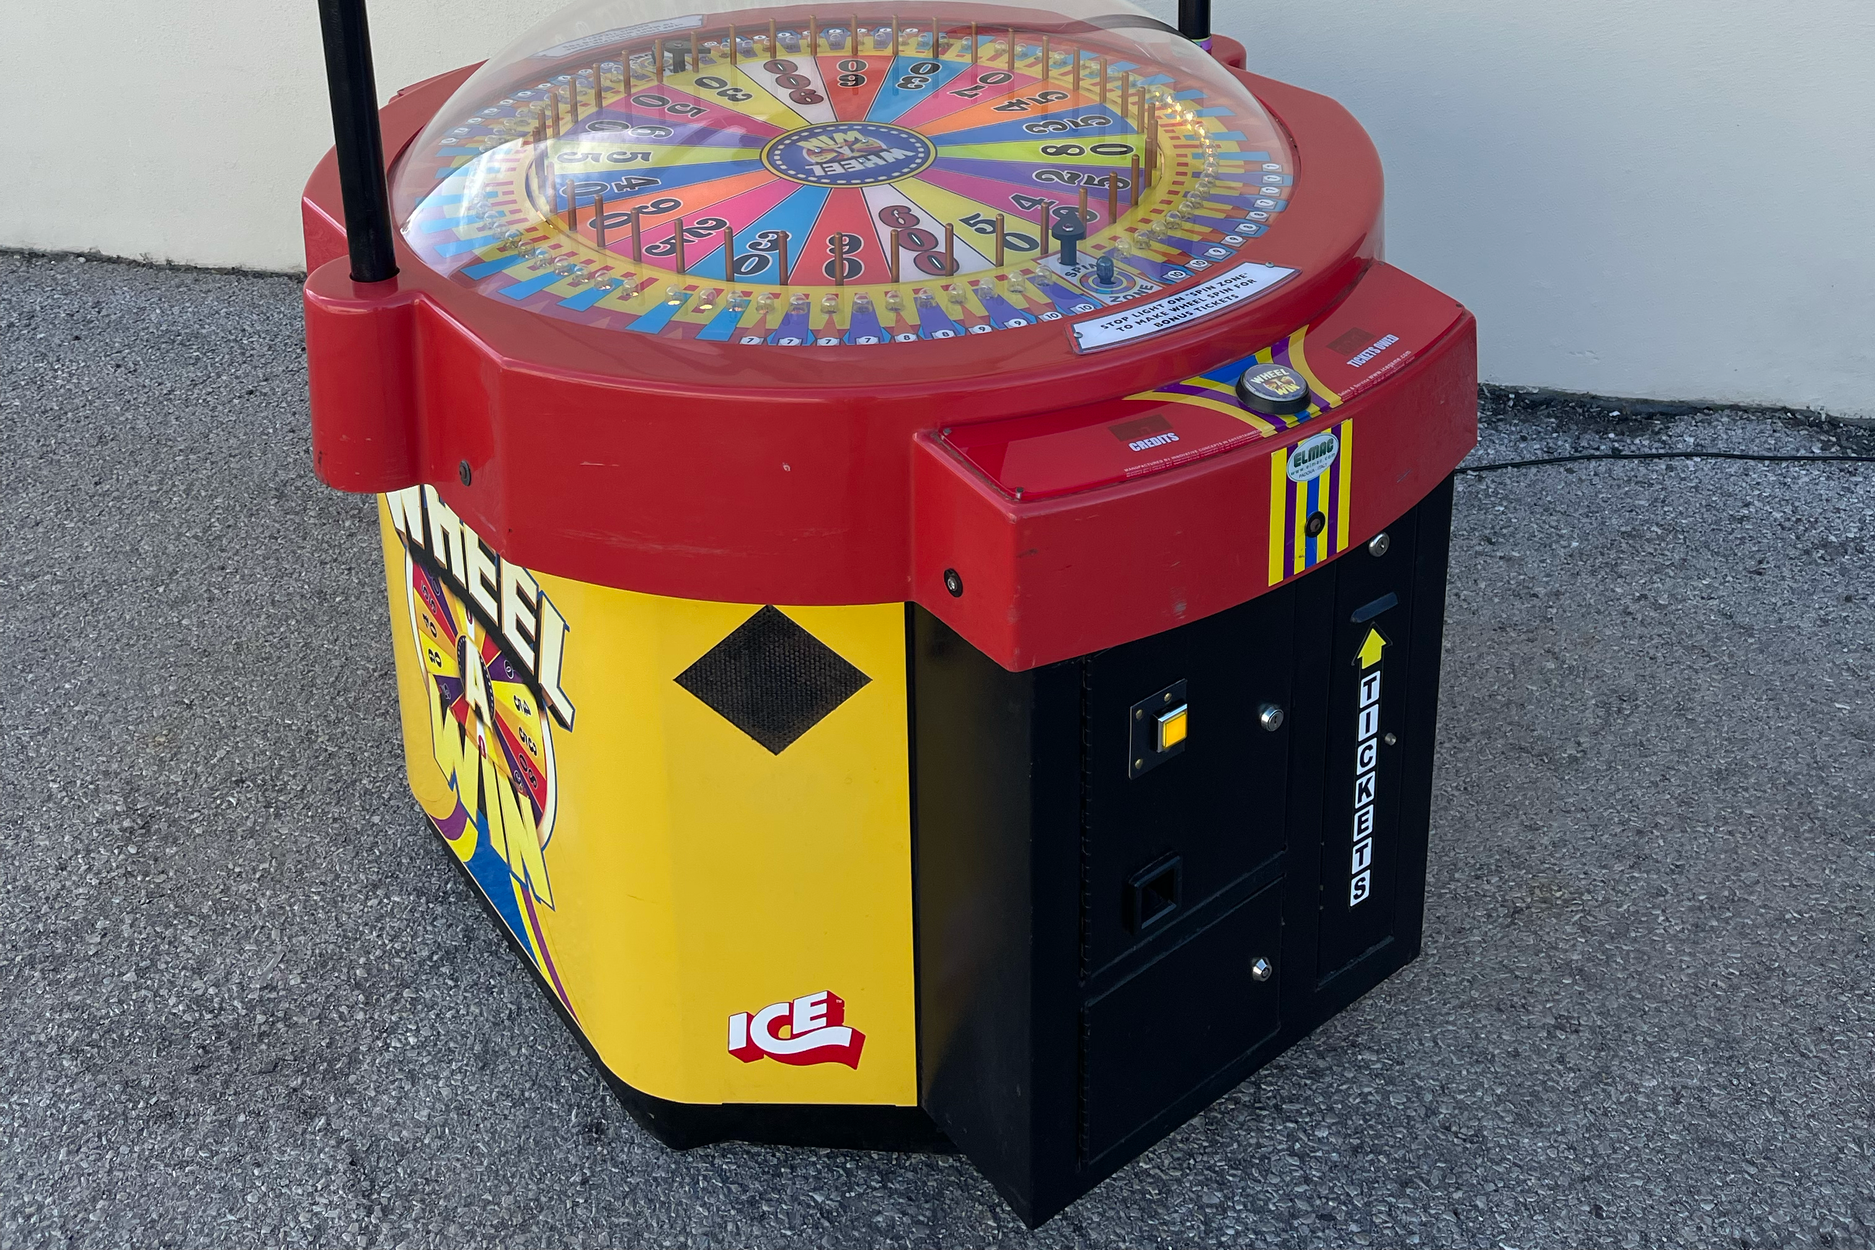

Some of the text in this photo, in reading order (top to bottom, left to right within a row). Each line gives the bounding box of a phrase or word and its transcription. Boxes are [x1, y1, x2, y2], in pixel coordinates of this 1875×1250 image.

[796, 131, 866, 151] WIN
[1039, 143, 1135, 158] 80
[804, 148, 917, 176] WHEEL
[1032, 168, 1132, 191] 25
[560, 175, 662, 197] 40
[642, 216, 729, 258] 25
[958, 211, 1040, 253] 50
[732, 229, 791, 277] 30
[822, 232, 864, 281] 90
[1100, 316, 1130, 330] STOP
[1132, 304, 1166, 323] LIGHT
[1167, 295, 1184, 306] ON
[1116, 278, 1257, 333] TO MAKE WHEEL SPIN FOR
[1154, 294, 1240, 329] BONUS TICKETS
[1346, 346, 1382, 368] TICKETS
[1250, 368, 1290, 384] WHEEL
[1274, 382, 1301, 396] WIN
[1128, 432, 1180, 452] CREDITS
[1293, 438, 1334, 468] ELMAC
[465, 636, 494, 732] A
[428, 671, 555, 911] WIN
[1352, 672, 1380, 905] TICKETS
[728, 990, 858, 1062] ICE
